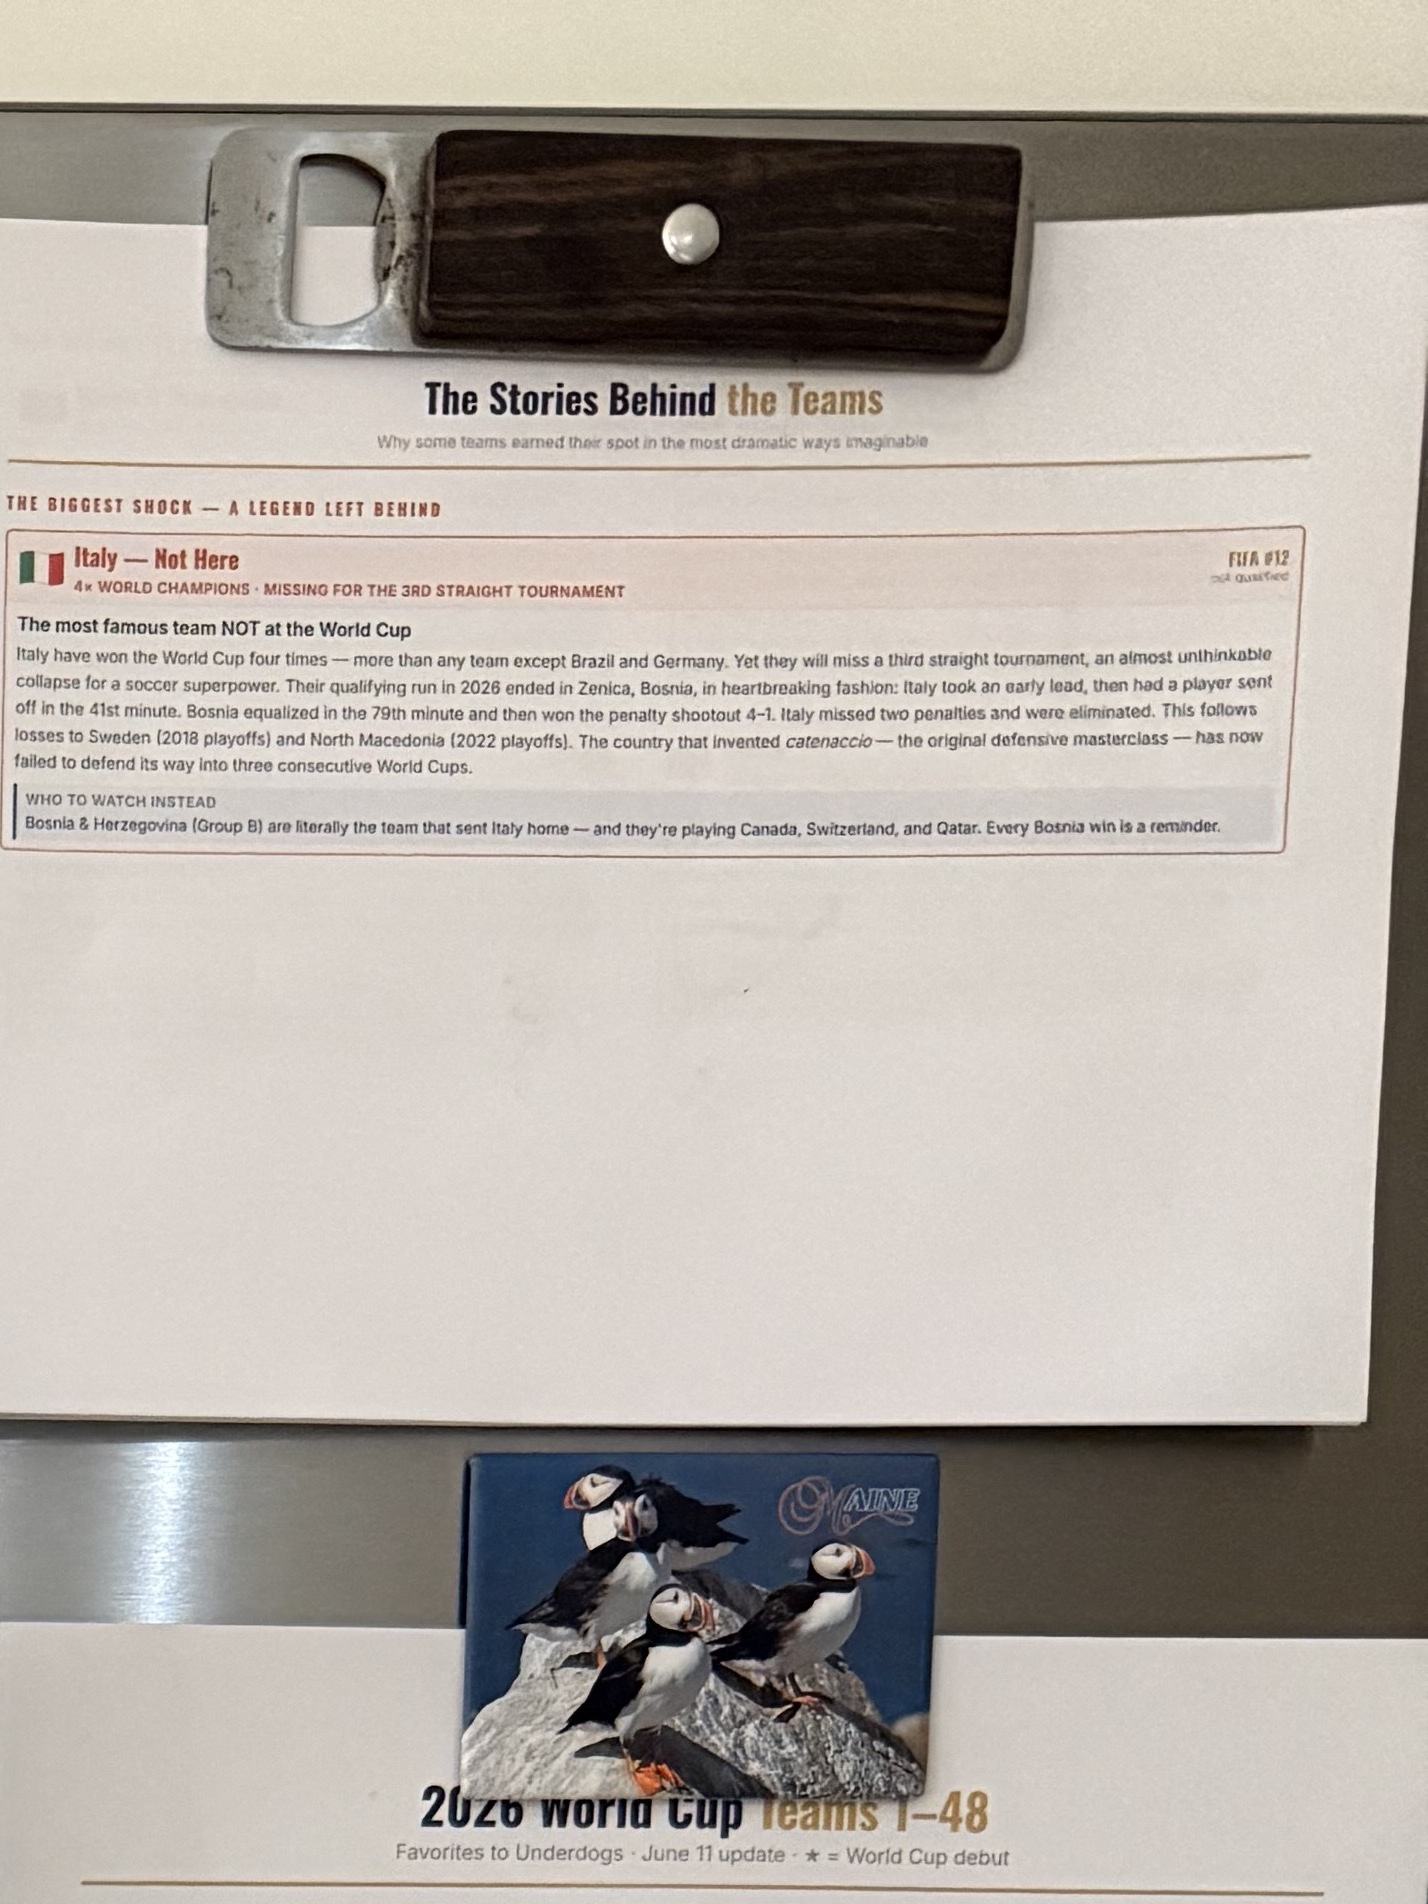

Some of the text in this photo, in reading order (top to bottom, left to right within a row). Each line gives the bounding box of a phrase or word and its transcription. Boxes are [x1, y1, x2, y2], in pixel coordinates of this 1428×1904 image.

[425, 381, 883, 416] The Stories Behind the Teams
[7, 496, 440, 517] THE BIGGEST SHOCK A LEGEND LEFT BEHIND
[75, 546, 239, 572] Italy Not Here
[18, 616, 411, 641] The most famous team NOT at the World Cup
[421, 1785, 523, 1829] 2026
[668, 1800, 743, 1838] Cup
[397, 1843, 1009, 1869] Favorites to Underdogs June 11 update World Cup debut
